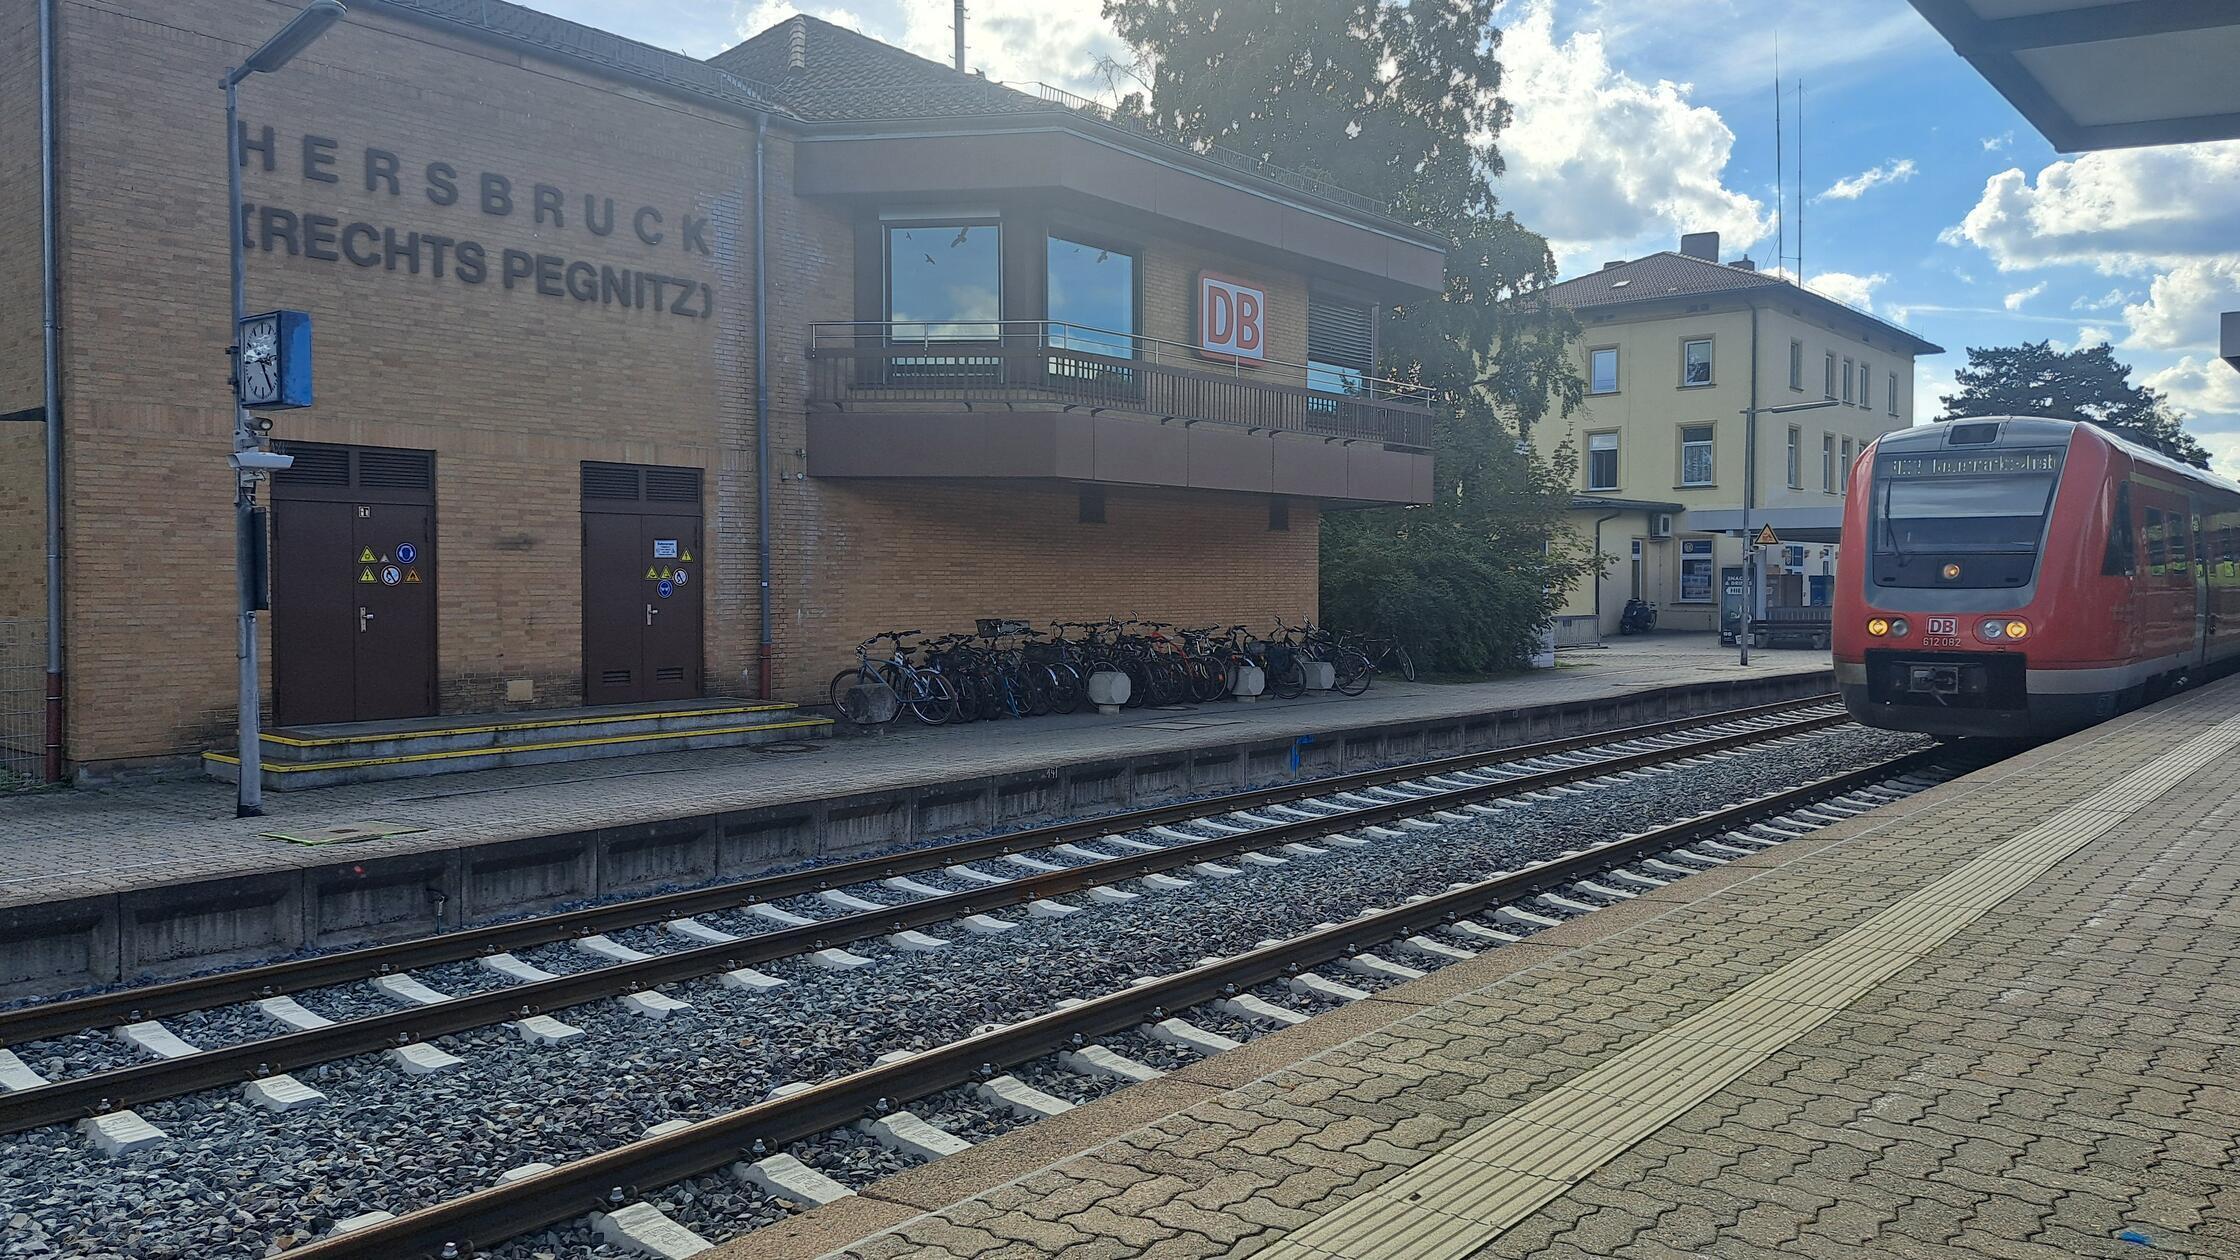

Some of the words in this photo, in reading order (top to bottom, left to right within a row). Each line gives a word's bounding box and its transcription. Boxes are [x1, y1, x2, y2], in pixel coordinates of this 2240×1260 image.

[238, 119, 711, 255] HERSBRUCK
[241, 203, 487, 284] (RECHTS
[503, 248, 712, 319] PEGNITZ)
[1208, 285, 1259, 350] DB
[1923, 637, 1940, 647] 612
[1942, 637, 1961, 647] 082
[1930, 620, 1954, 633] DB
